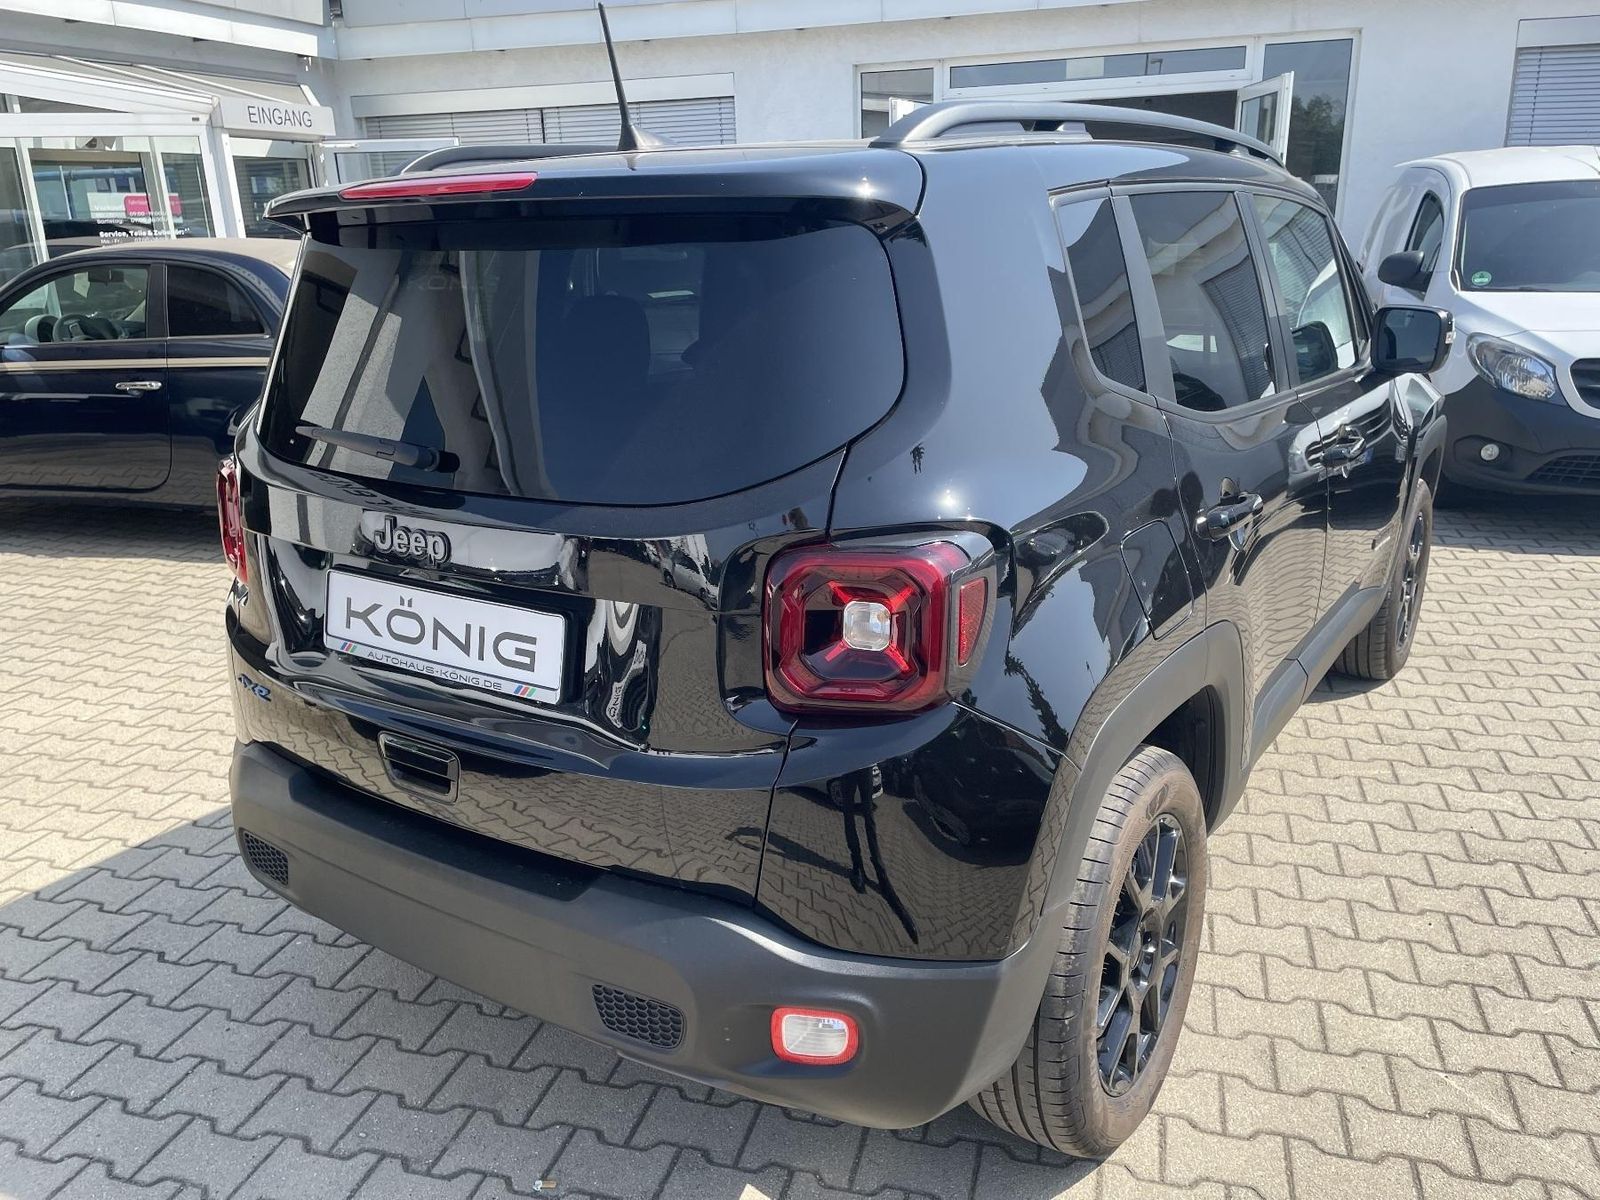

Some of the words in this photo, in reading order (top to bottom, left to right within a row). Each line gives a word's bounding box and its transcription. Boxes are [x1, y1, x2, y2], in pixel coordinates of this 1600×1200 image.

[248, 105, 313, 128] EINGANG
[99, 230, 129, 238] Service,
[373, 515, 451, 567] Jeep
[345, 595, 538, 673] KÖNIG
[367, 650, 502, 691] AUTOHAUS-KÖNIG.DE
